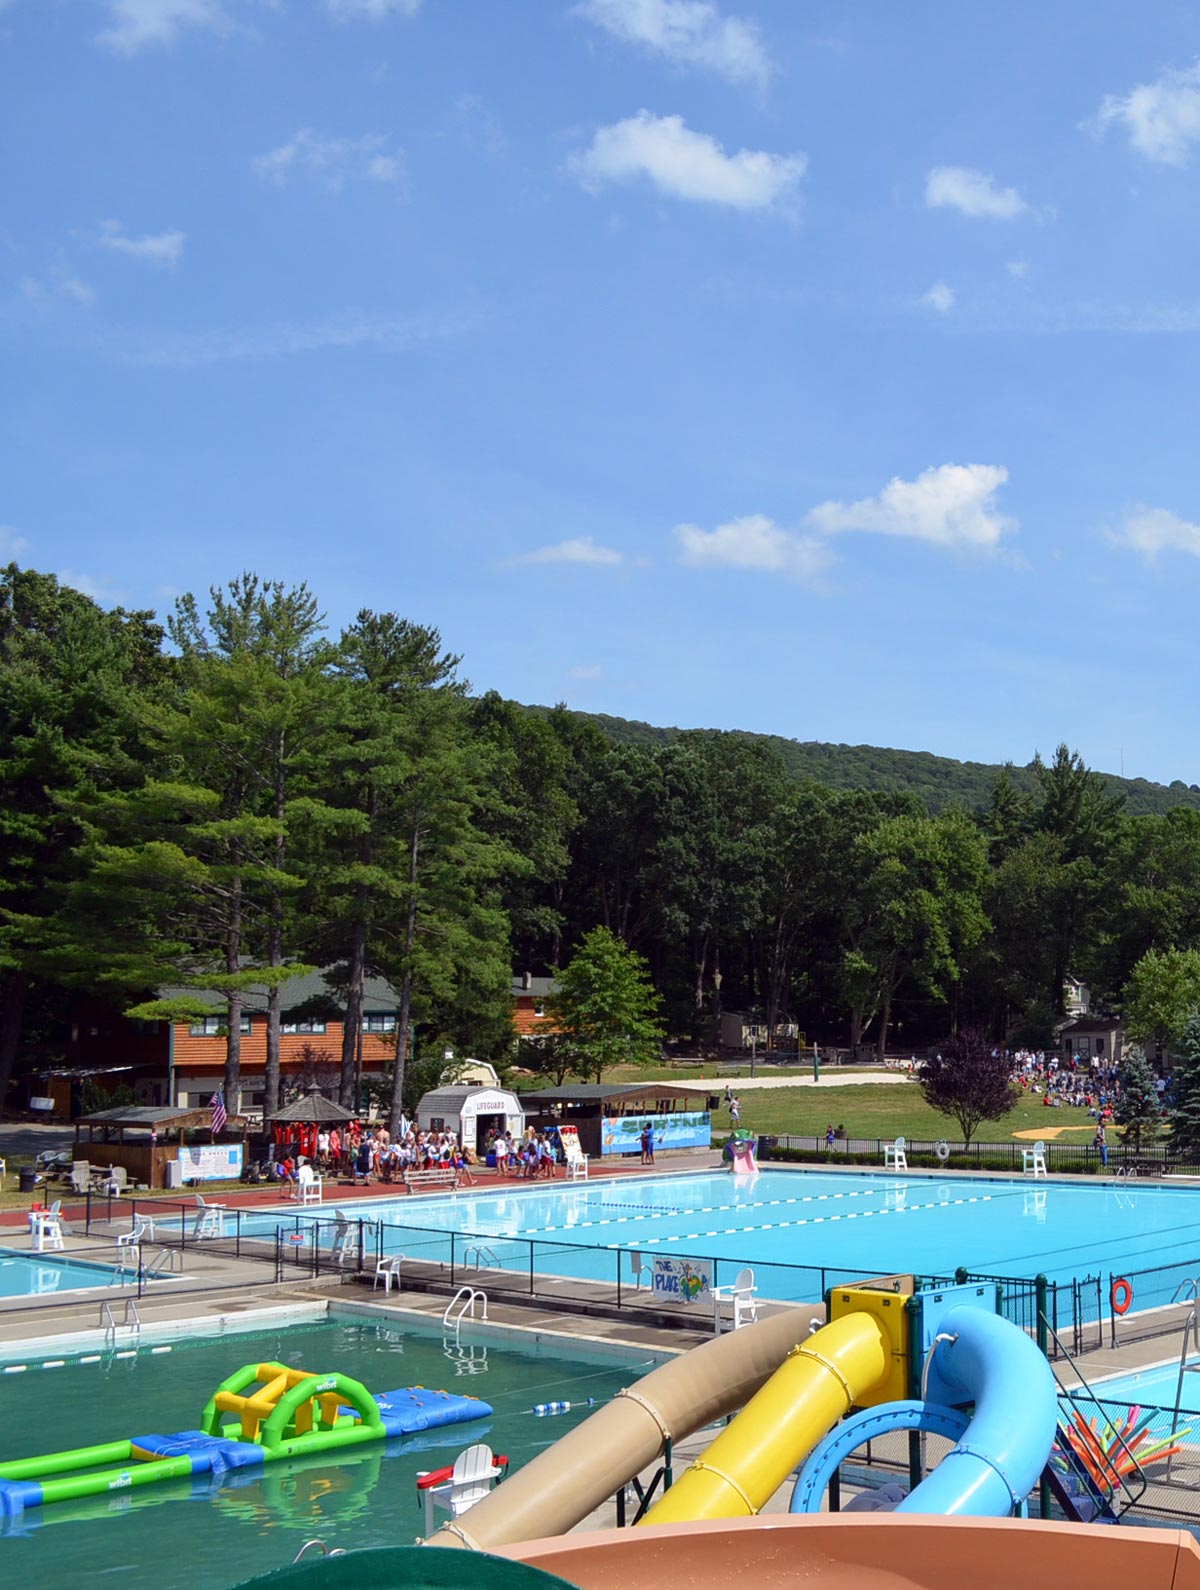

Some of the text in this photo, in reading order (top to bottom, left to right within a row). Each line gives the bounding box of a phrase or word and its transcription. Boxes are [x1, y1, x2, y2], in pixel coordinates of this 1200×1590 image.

[476, 1101, 505, 1110] LIFEGUARD
[316, 1381, 337, 1391] wibit
[109, 1477, 132, 1489] wibit
